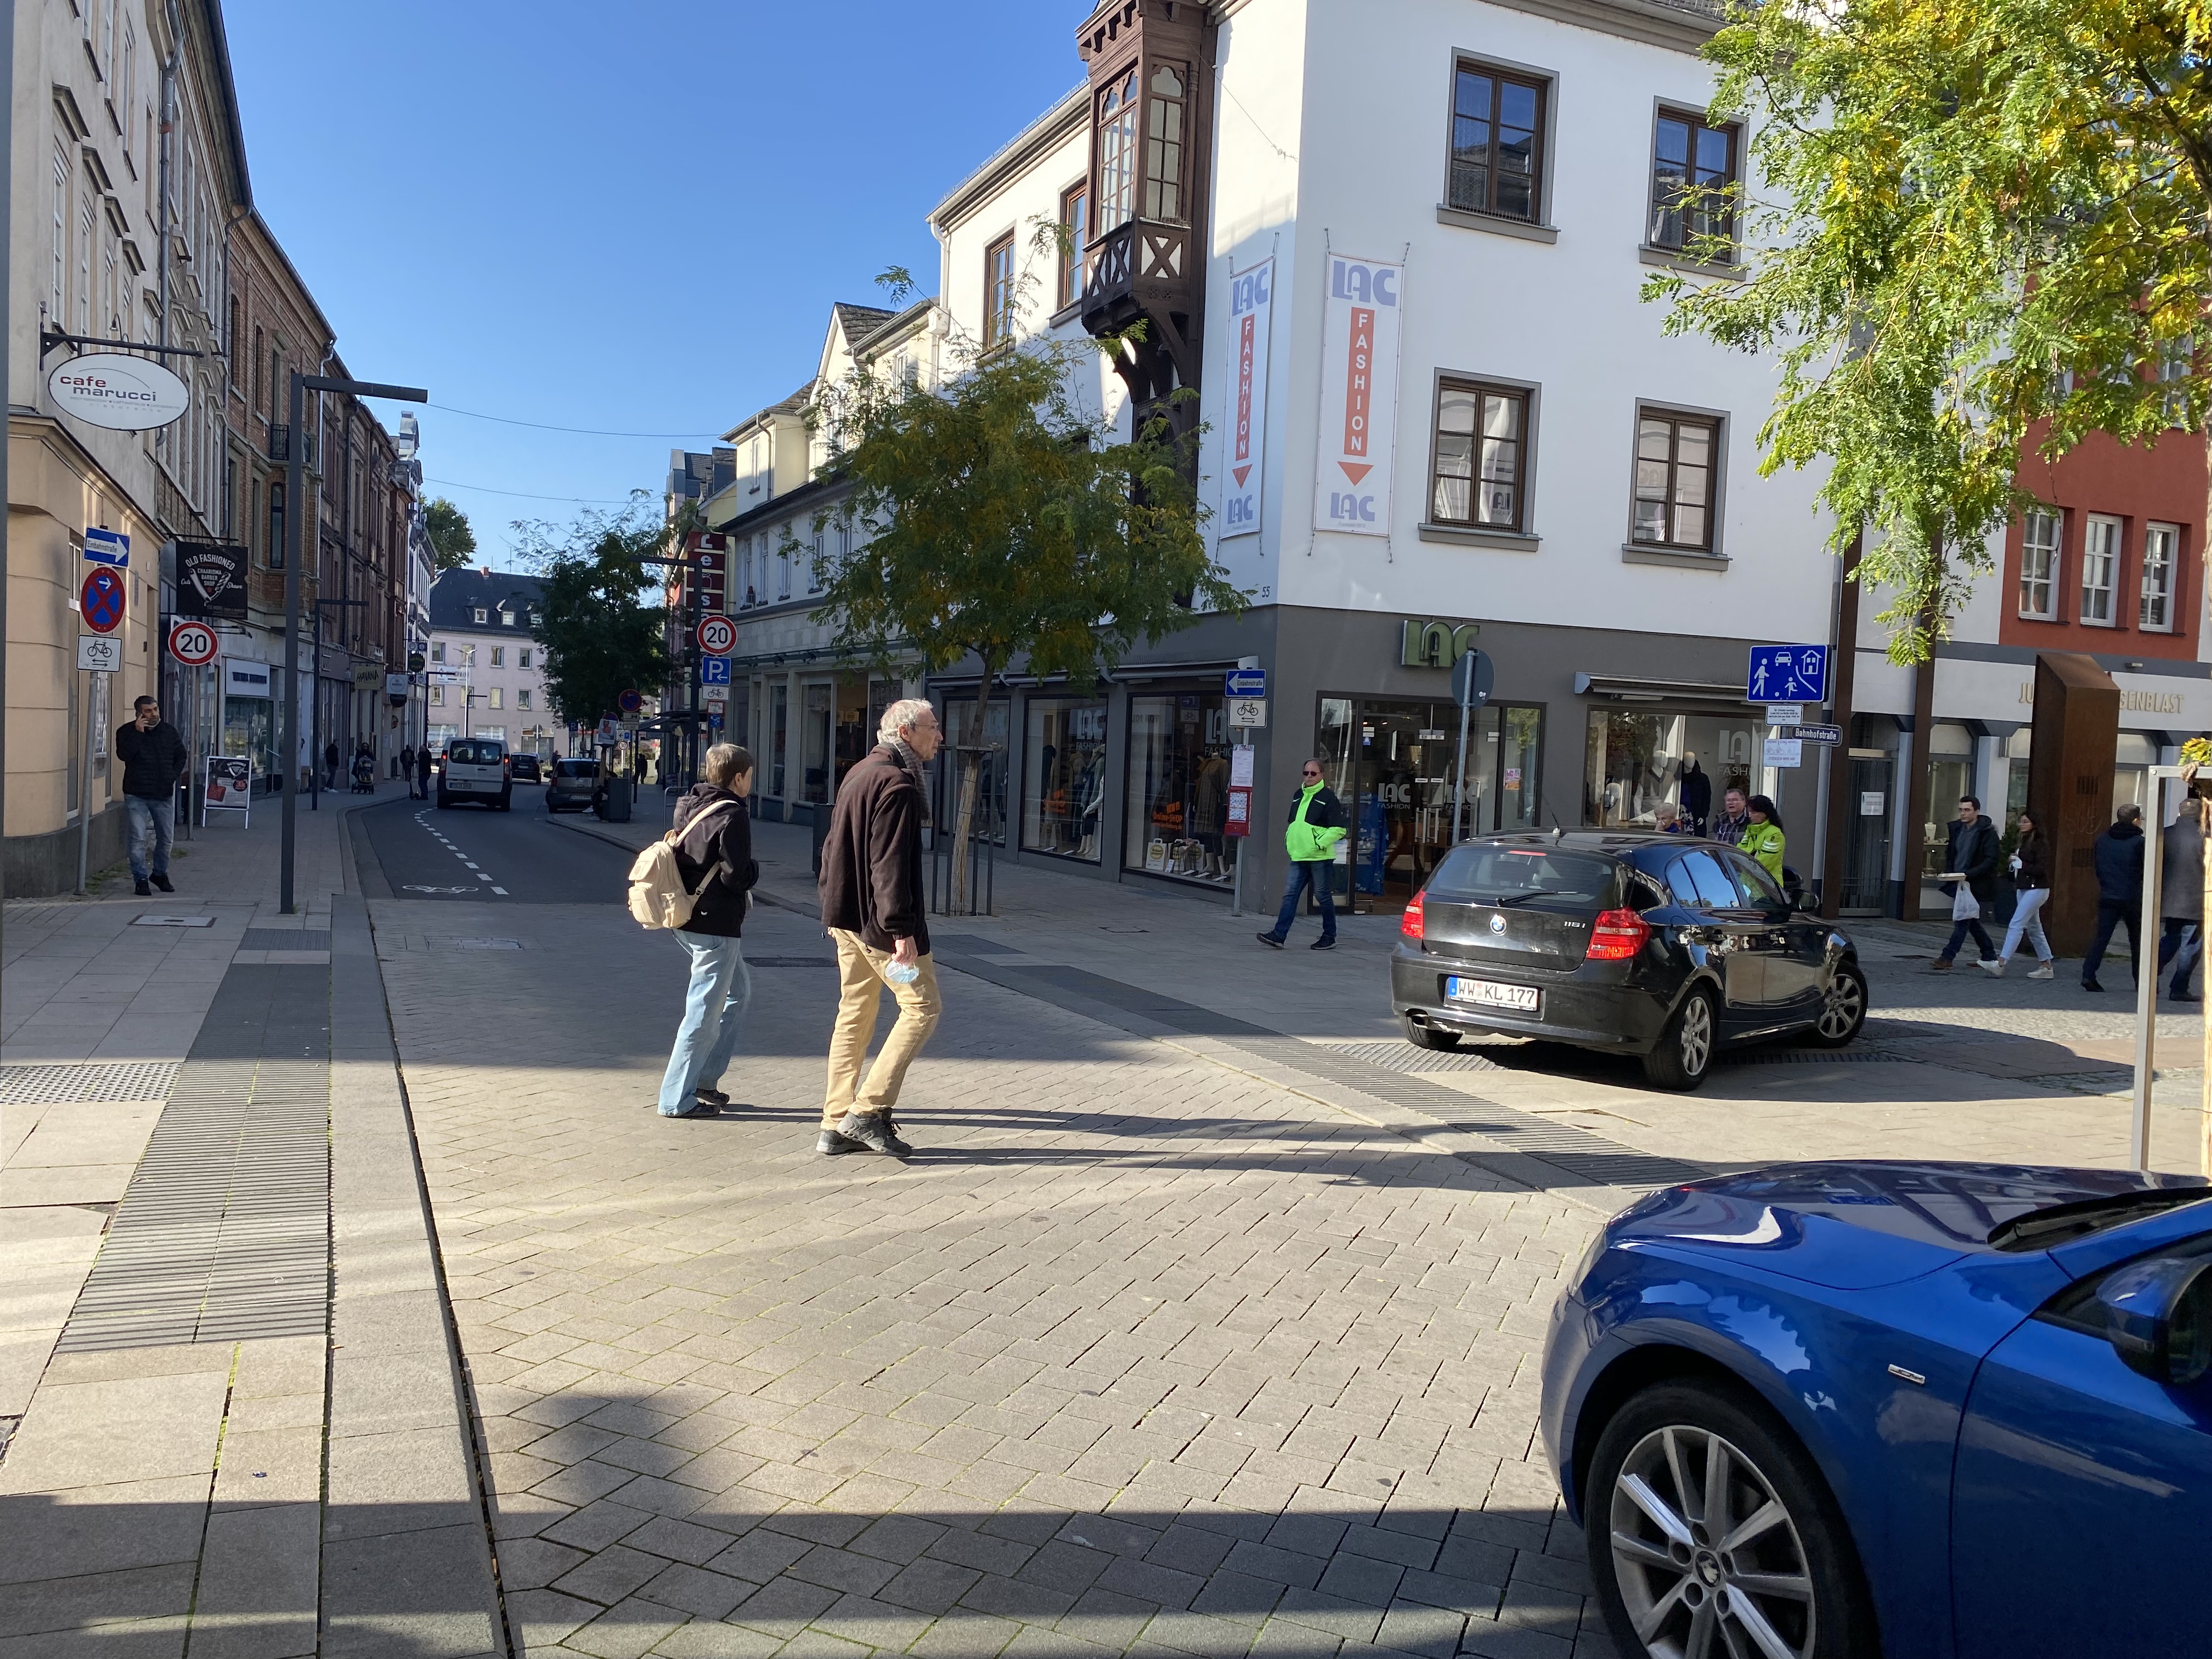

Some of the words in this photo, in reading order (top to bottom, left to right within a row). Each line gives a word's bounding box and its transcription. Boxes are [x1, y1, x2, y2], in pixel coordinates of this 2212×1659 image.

[1232, 266, 1268, 317] LAC
[1332, 260, 1396, 307] LAC
[60, 376, 106, 387] cafe
[1239, 319, 1251, 455] FASHION
[1351, 313, 1368, 451] FASHION
[73, 386, 156, 402] marucci
[1228, 494, 1253, 524] LAC
[1330, 492, 1375, 522] LAC
[185, 555, 199, 567] OLD
[199, 554, 235, 571] FASHIONED
[1262, 585, 1270, 597] 55
[180, 634, 207, 653] 20
[707, 627, 728, 644] 20
[356, 669, 379, 683] HAVANA
[708, 660, 724, 681] P
[2019, 682, 2034, 704] JU
[2119, 690, 2185, 713] GENBLAST
[1076, 709, 1103, 740] LAC
[1796, 727, 1837, 740] Bahnhofstraße
[1205, 746, 1233, 757] FASHIO
[1718, 730, 1761, 764] LA
[1378, 783, 1410, 803] LAC
[1458, 981, 1476, 996] WW
[1485, 985, 1503, 1000] KL
[1507, 988, 1536, 1004] 177
